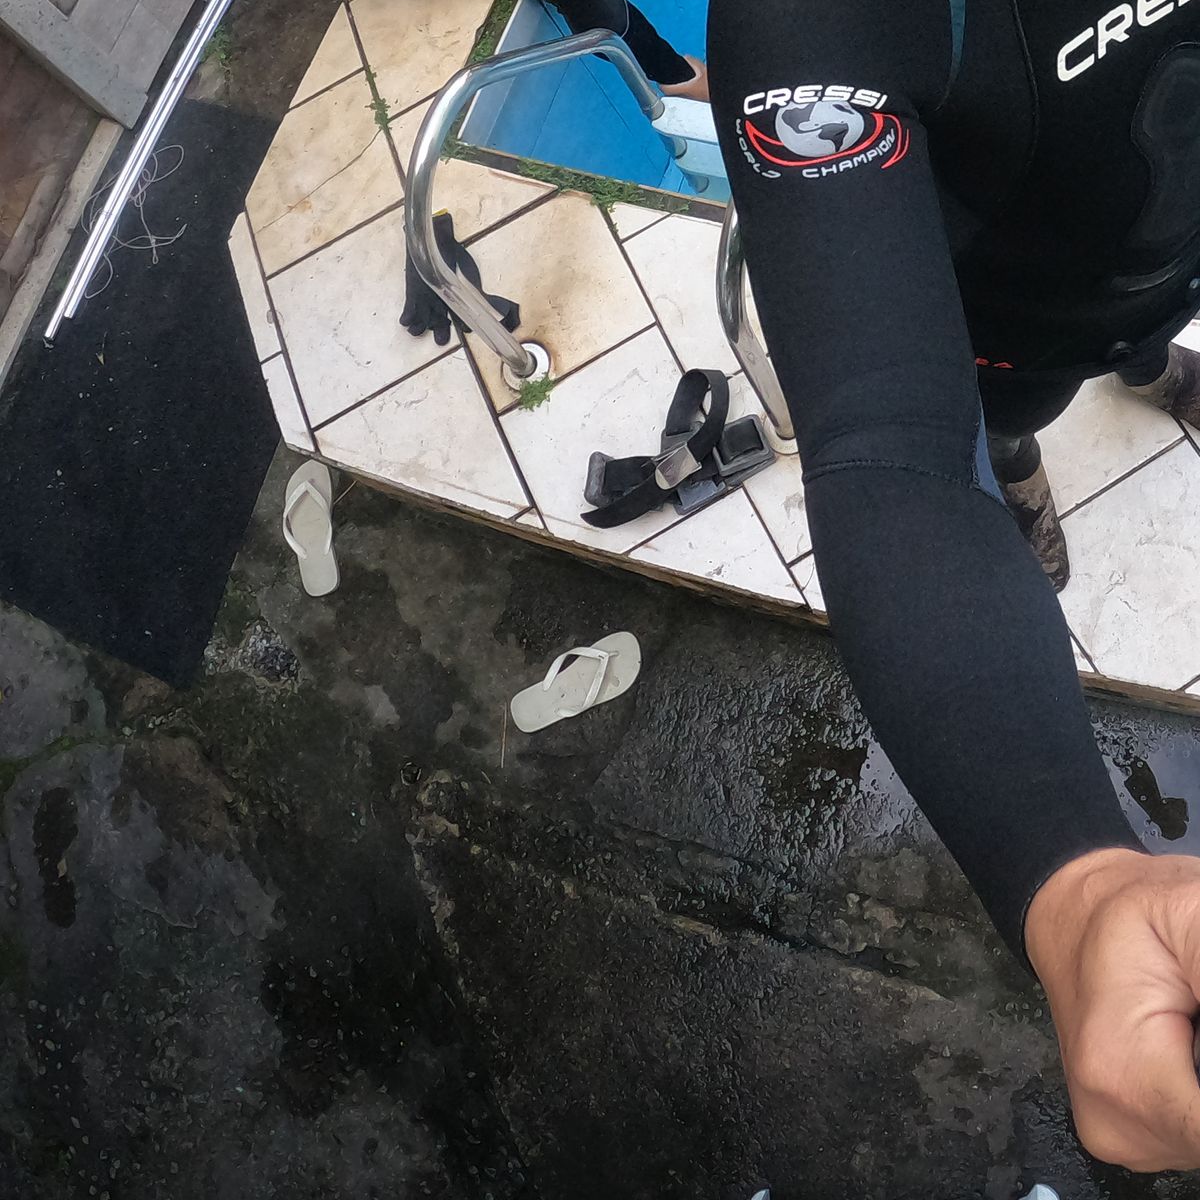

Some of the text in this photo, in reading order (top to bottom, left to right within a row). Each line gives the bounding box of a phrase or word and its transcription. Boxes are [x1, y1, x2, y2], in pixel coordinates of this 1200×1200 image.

[743, 84, 888, 116] CRESSI
[736, 118, 896, 179] WORLD CHAMPION
